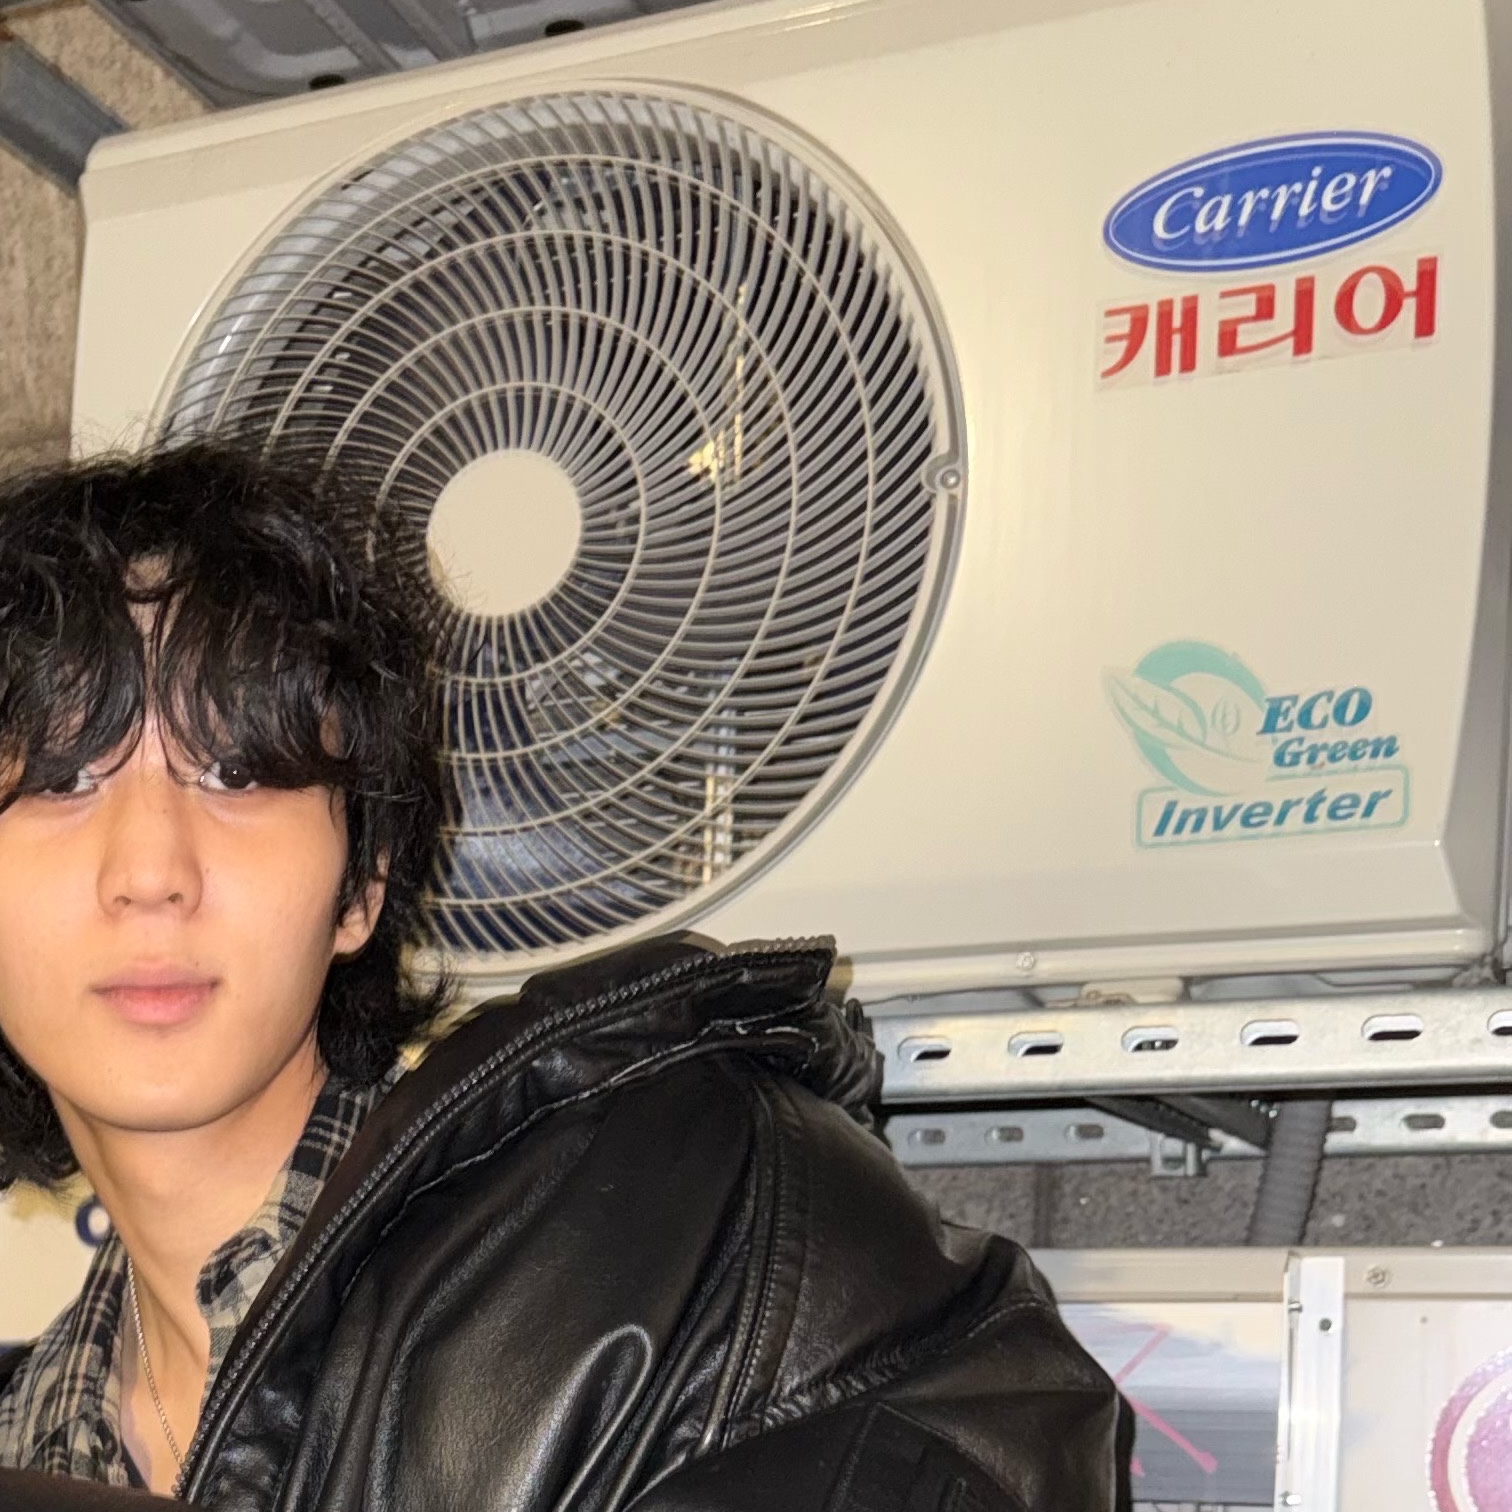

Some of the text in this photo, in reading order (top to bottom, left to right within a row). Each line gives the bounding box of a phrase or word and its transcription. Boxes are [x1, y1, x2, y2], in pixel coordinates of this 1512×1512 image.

[1153, 166, 1393, 241] Carrier
[1100, 256, 1438, 379] 캐리어
[1256, 686, 1373, 736] ECO
[1273, 734, 1399, 768] Green
[1153, 785, 1393, 838] Inverter
